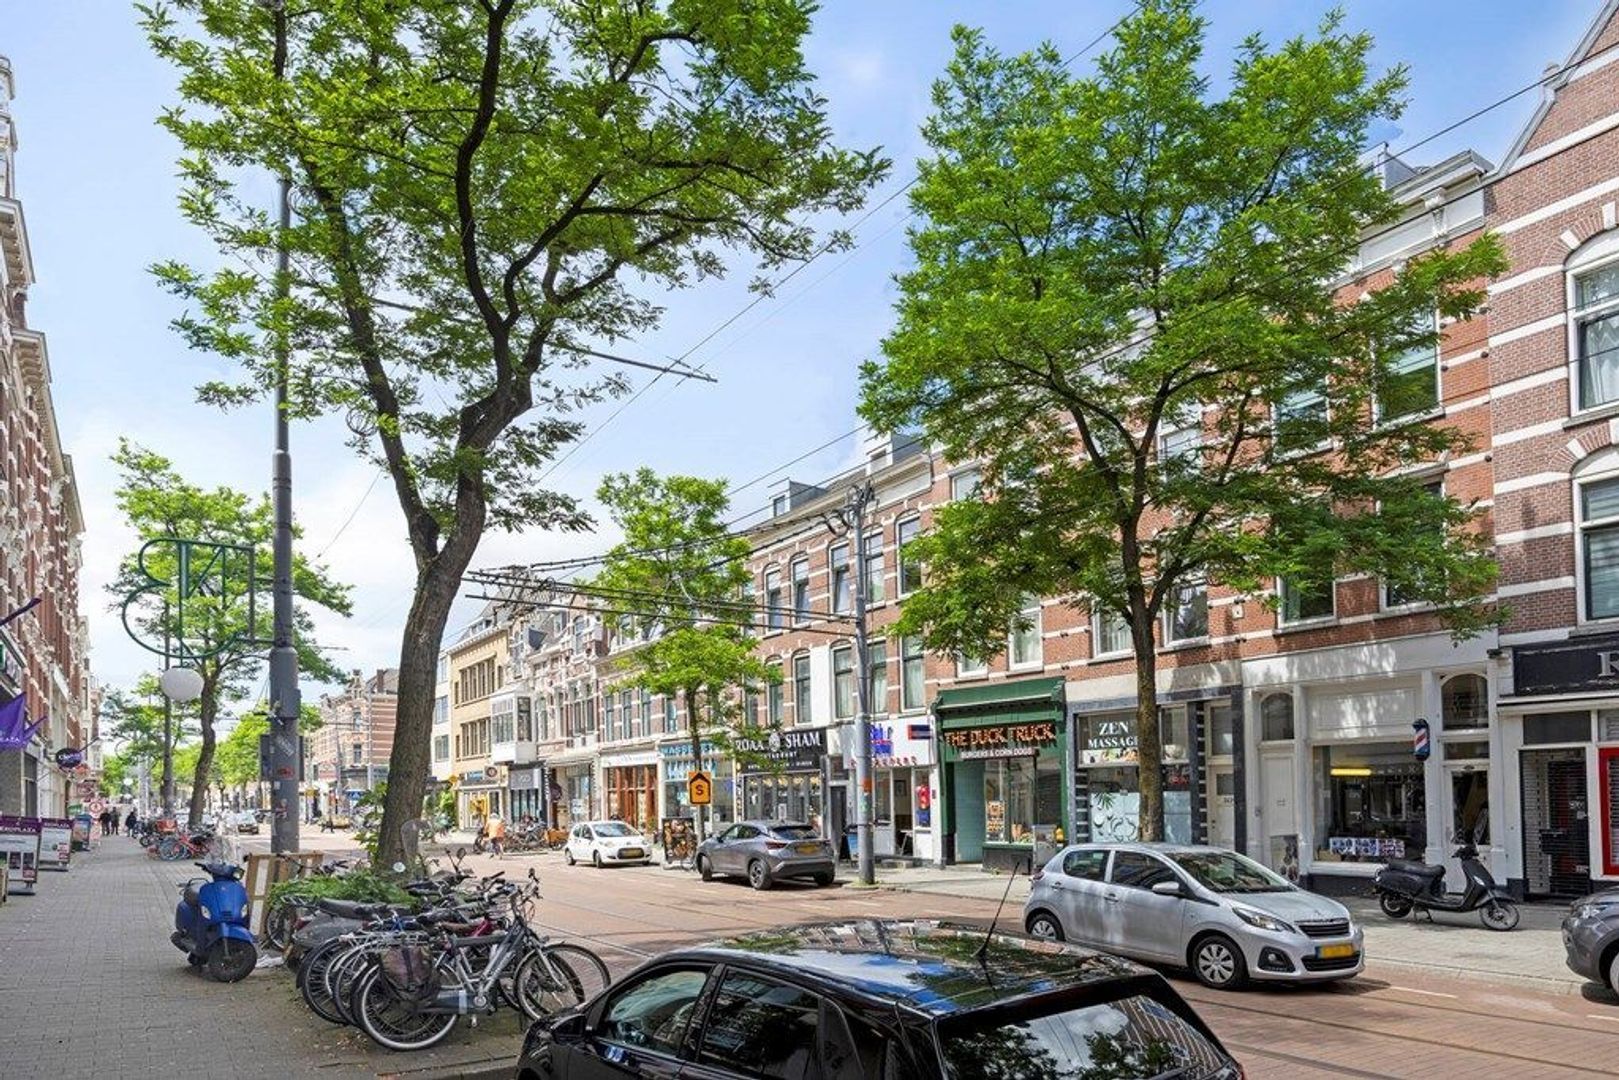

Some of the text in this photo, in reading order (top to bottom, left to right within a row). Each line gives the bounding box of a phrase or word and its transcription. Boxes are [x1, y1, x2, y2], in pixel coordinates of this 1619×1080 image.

[944, 723, 1056, 746] THE DUCK TRUCK
[1099, 721, 1129, 736] ZEN
[785, 731, 821, 748] SHAM
[695, 784, 704, 796] S
